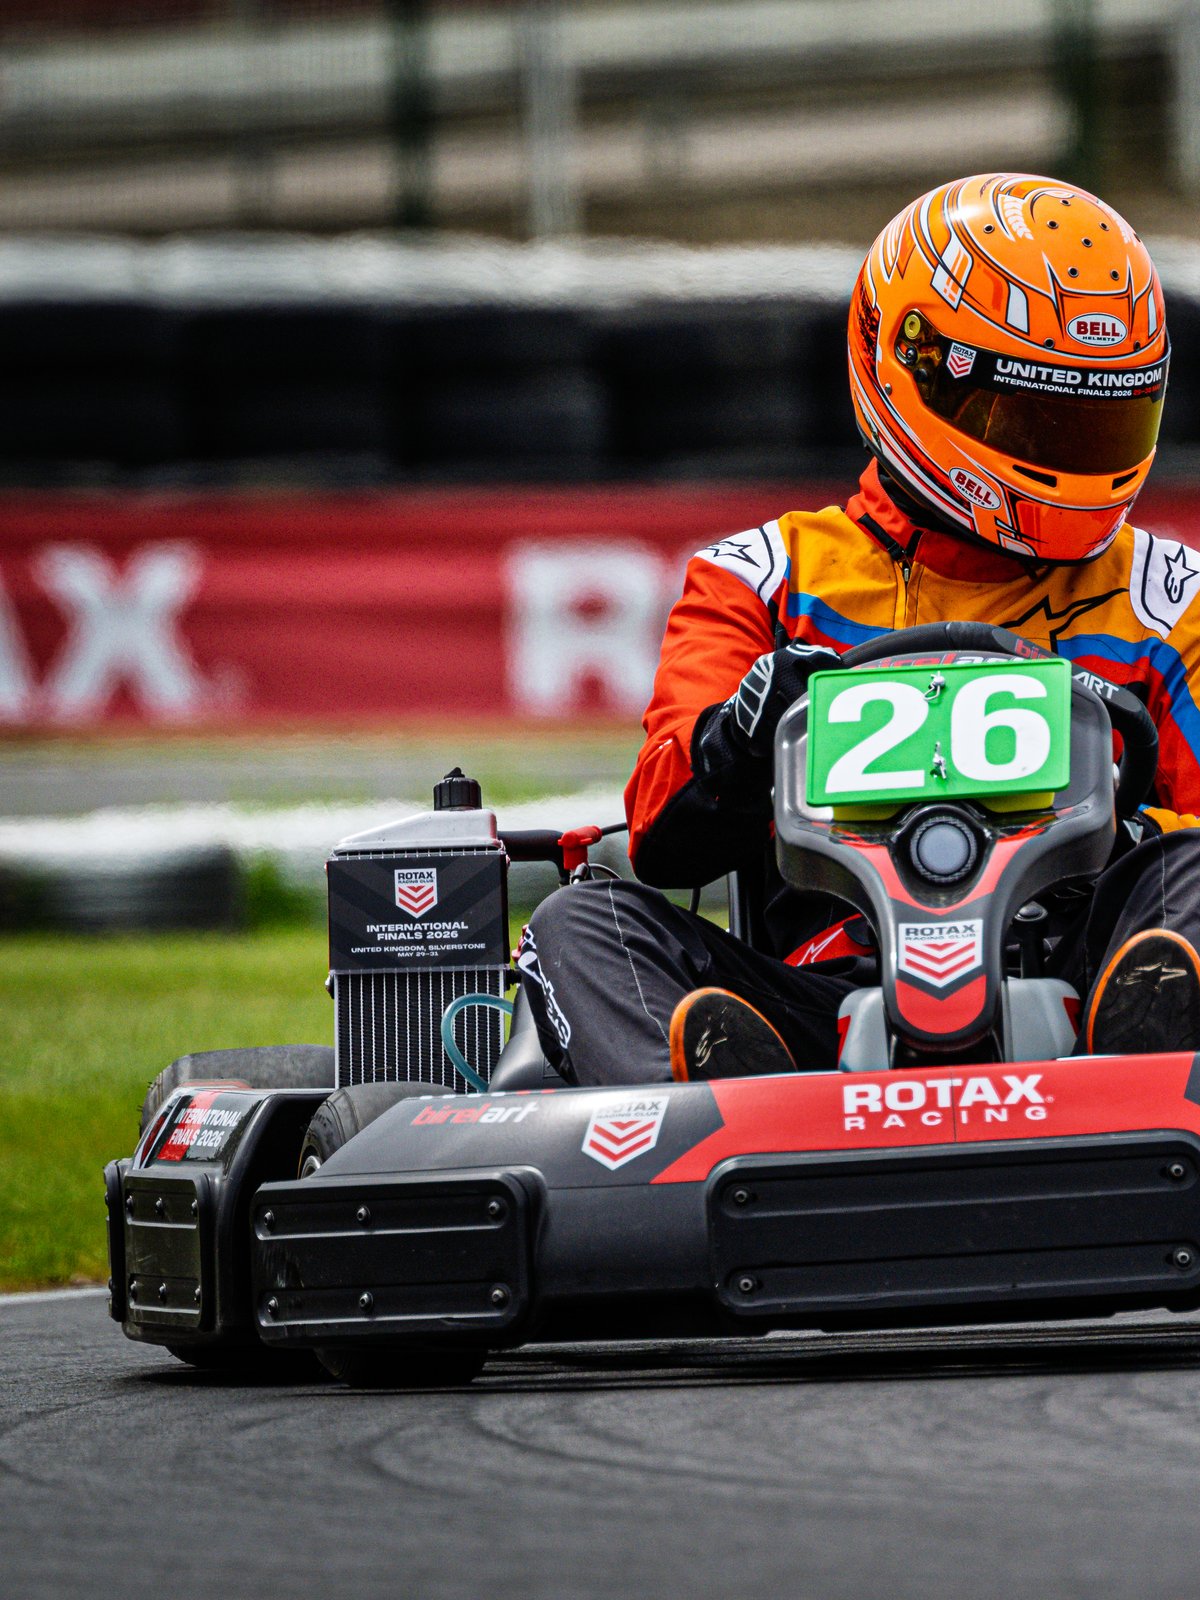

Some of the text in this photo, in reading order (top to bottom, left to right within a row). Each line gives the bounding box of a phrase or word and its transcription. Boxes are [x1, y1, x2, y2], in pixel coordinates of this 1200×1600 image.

[1076, 321, 1120, 337] BELL
[952, 345, 974, 358] ROTAX
[996, 359, 1162, 387] UNITED KINGDOM
[993, 374, 1076, 395] INTERNATIONAL
[1077, 388, 1111, 397] FINALS
[1112, 389, 1132, 397] 2026
[955, 471, 992, 505] BELL
[1072, 671, 1119, 700] ART
[825, 674, 1051, 794] 26
[397, 871, 433, 880] ROTAX
[366, 921, 468, 933] INTERNATIONAL
[377, 930, 459, 941] FINALS 2026
[905, 924, 975, 937] ROTAX
[383, 945, 427, 953] KINGDOM,
[428, 943, 486, 951] SILVERSTONE
[843, 1074, 1045, 1114] ROTAX
[411, 1101, 540, 1126] birelart
[598, 1101, 662, 1113] TAX
[174, 1108, 242, 1127] INTERNATIONAL
[844, 1105, 1048, 1131] RACING
[168, 1128, 224, 1147] FINALS 2026
